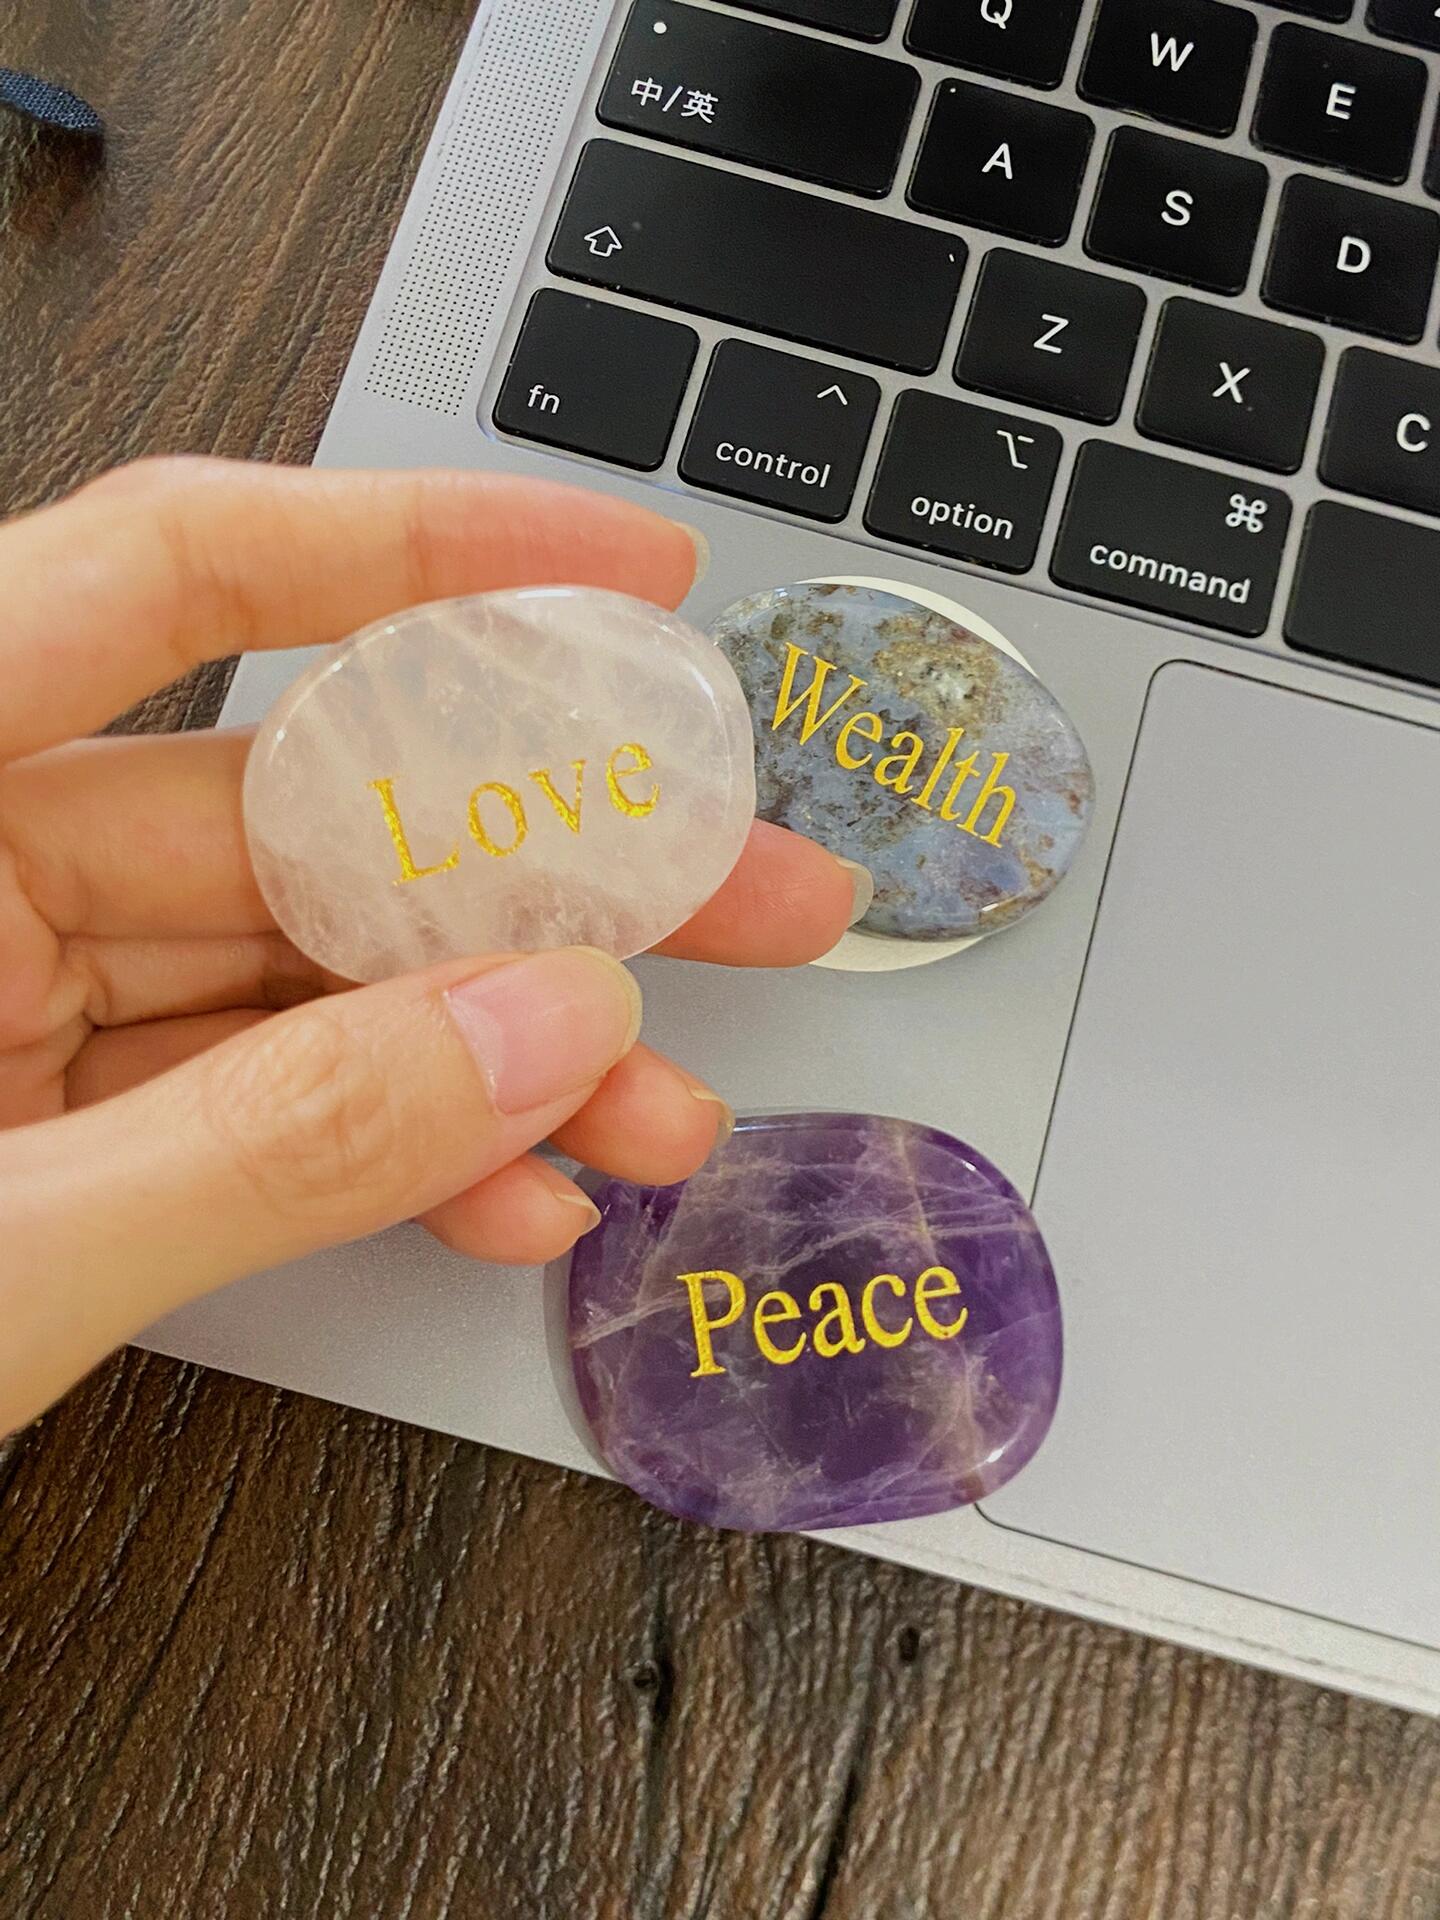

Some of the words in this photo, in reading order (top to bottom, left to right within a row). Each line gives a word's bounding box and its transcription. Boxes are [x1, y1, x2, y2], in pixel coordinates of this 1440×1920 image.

[1150, 32, 1194, 72] W
[631, 77, 719, 124] 中/英
[1326, 83, 1356, 119] E
[982, 143, 1013, 179] A
[1161, 190, 1194, 226] S
[1337, 236, 1371, 273] D
[1034, 314, 1069, 354] Z
[528, 384, 560, 414] fn
[1213, 362, 1250, 403] X
[1396, 413, 1431, 452] C
[715, 441, 831, 488] control
[910, 496, 1014, 540] option
[1090, 544, 1251, 604] command
[771, 642, 1017, 848] Wealth
[367, 742, 662, 887] Love
[677, 1266, 968, 1378] Peace
